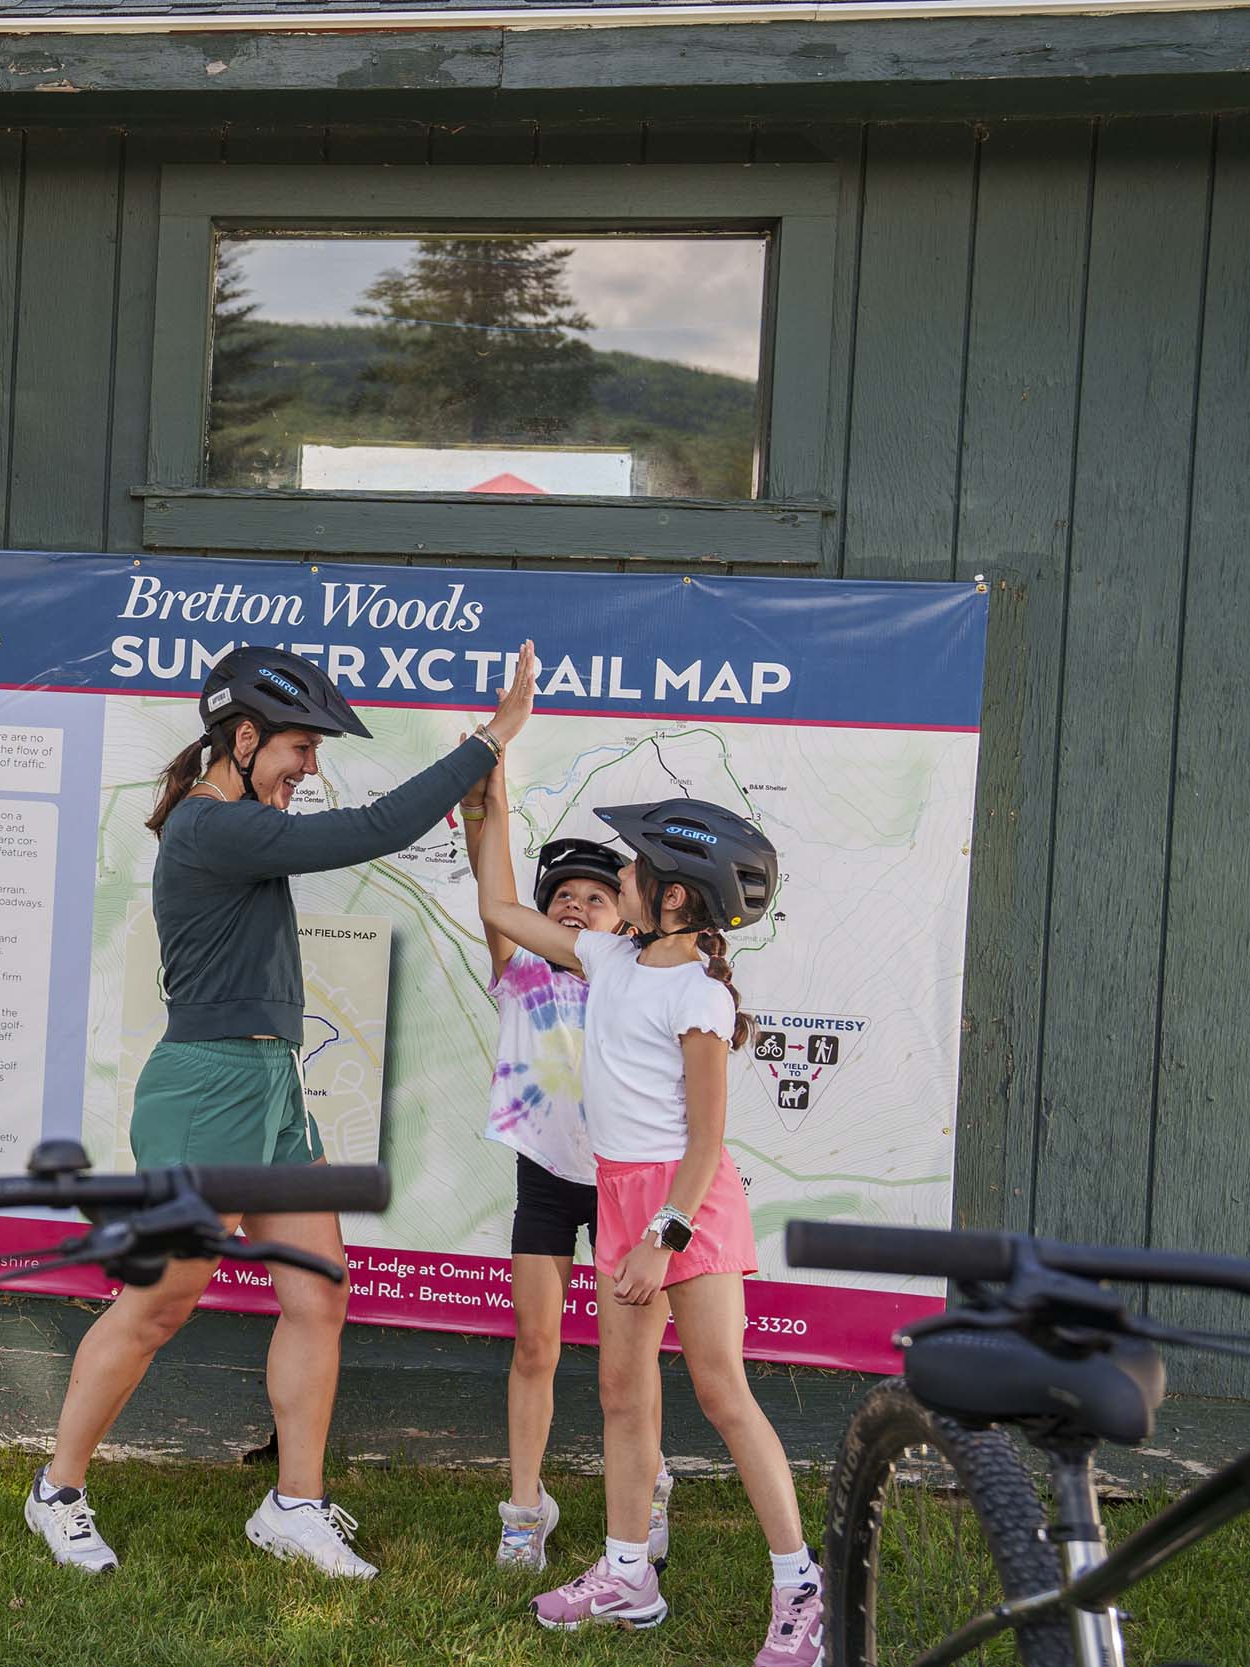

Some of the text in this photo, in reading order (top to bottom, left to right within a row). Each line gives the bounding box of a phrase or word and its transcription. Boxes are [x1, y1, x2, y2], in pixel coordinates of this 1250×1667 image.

[117, 576, 483, 632] Bretton Woods
[377, 647, 455, 694] XC
[654, 658, 791, 705] MAP
[270, 674, 299, 696] GIRO
[655, 731, 666, 740] 14
[16, 746, 39, 755] flow
[41, 747, 53, 756] of
[0, 758, 11, 767] of
[13, 758, 46, 768] traffic.
[669, 778, 694, 786] TUNNEL
[749, 784, 764, 792] B&M
[0, 812, 13, 820] on
[682, 829, 718, 845] GIRO
[314, 929, 352, 939] FIELDS
[353, 931, 377, 940] MAP
[2, 972, 21, 981] firm
[1, 1007, 17, 1016] the
[781, 1016, 866, 1032] COURTESY
[782, 1062, 809, 1071] YIELD
[789, 1069, 801, 1077] TO
[368, 1256, 415, 1279] Lodge
[419, 1261, 436, 1276] at
[440, 1262, 485, 1280] Omni
[377, 1282, 404, 1299] Rd.
[419, 1286, 482, 1307] Bretton
